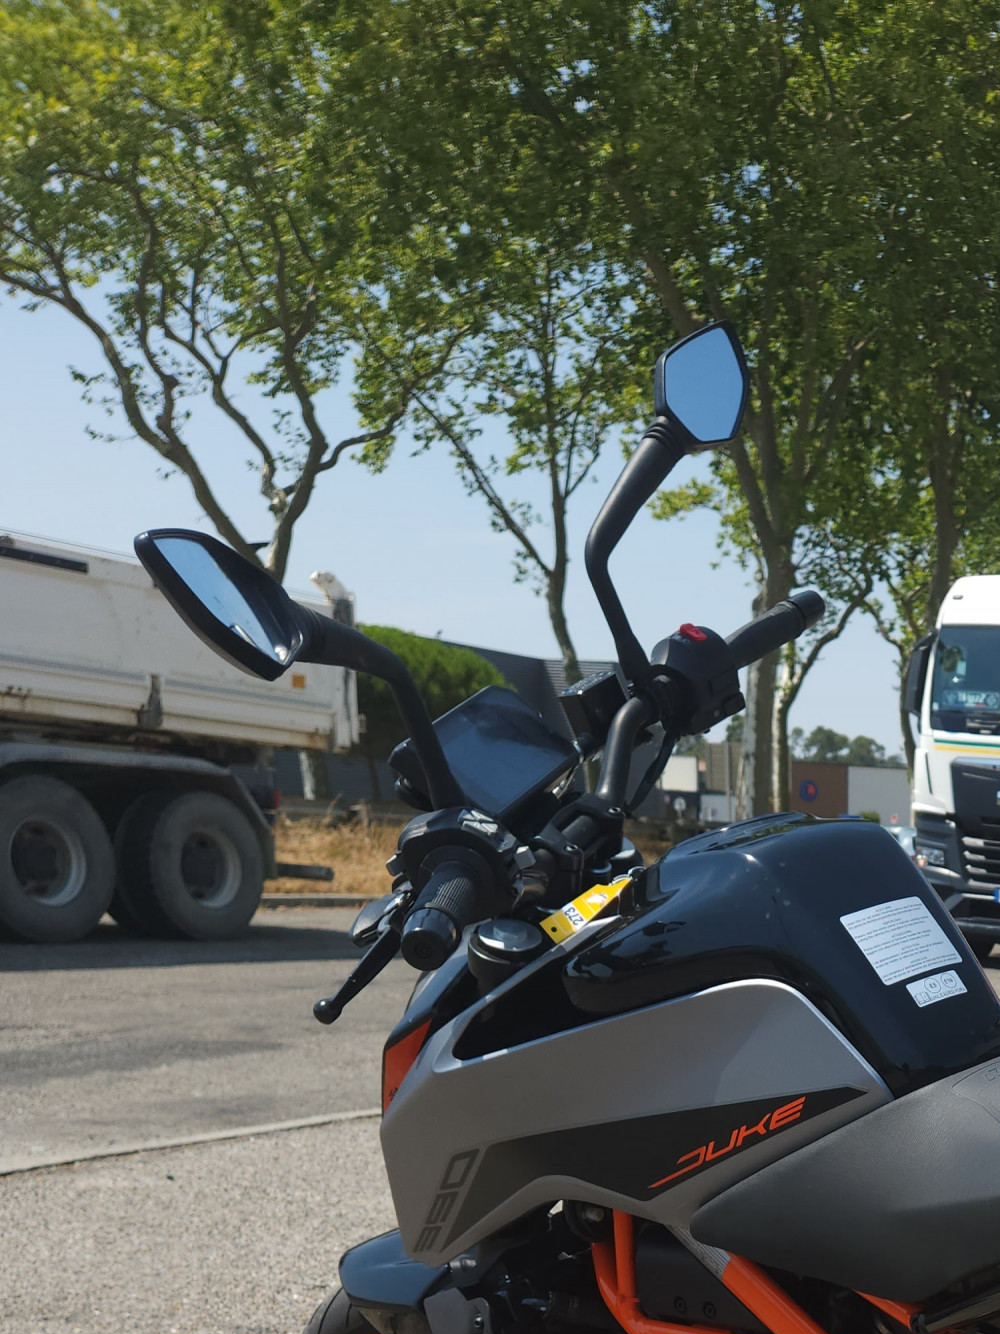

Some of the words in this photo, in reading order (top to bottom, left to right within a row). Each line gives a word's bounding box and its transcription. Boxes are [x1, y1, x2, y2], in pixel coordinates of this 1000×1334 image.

[564, 906, 584, 926] 273
[648, 1096, 806, 1189] DUKE
[413, 1148, 480, 1253] 390
